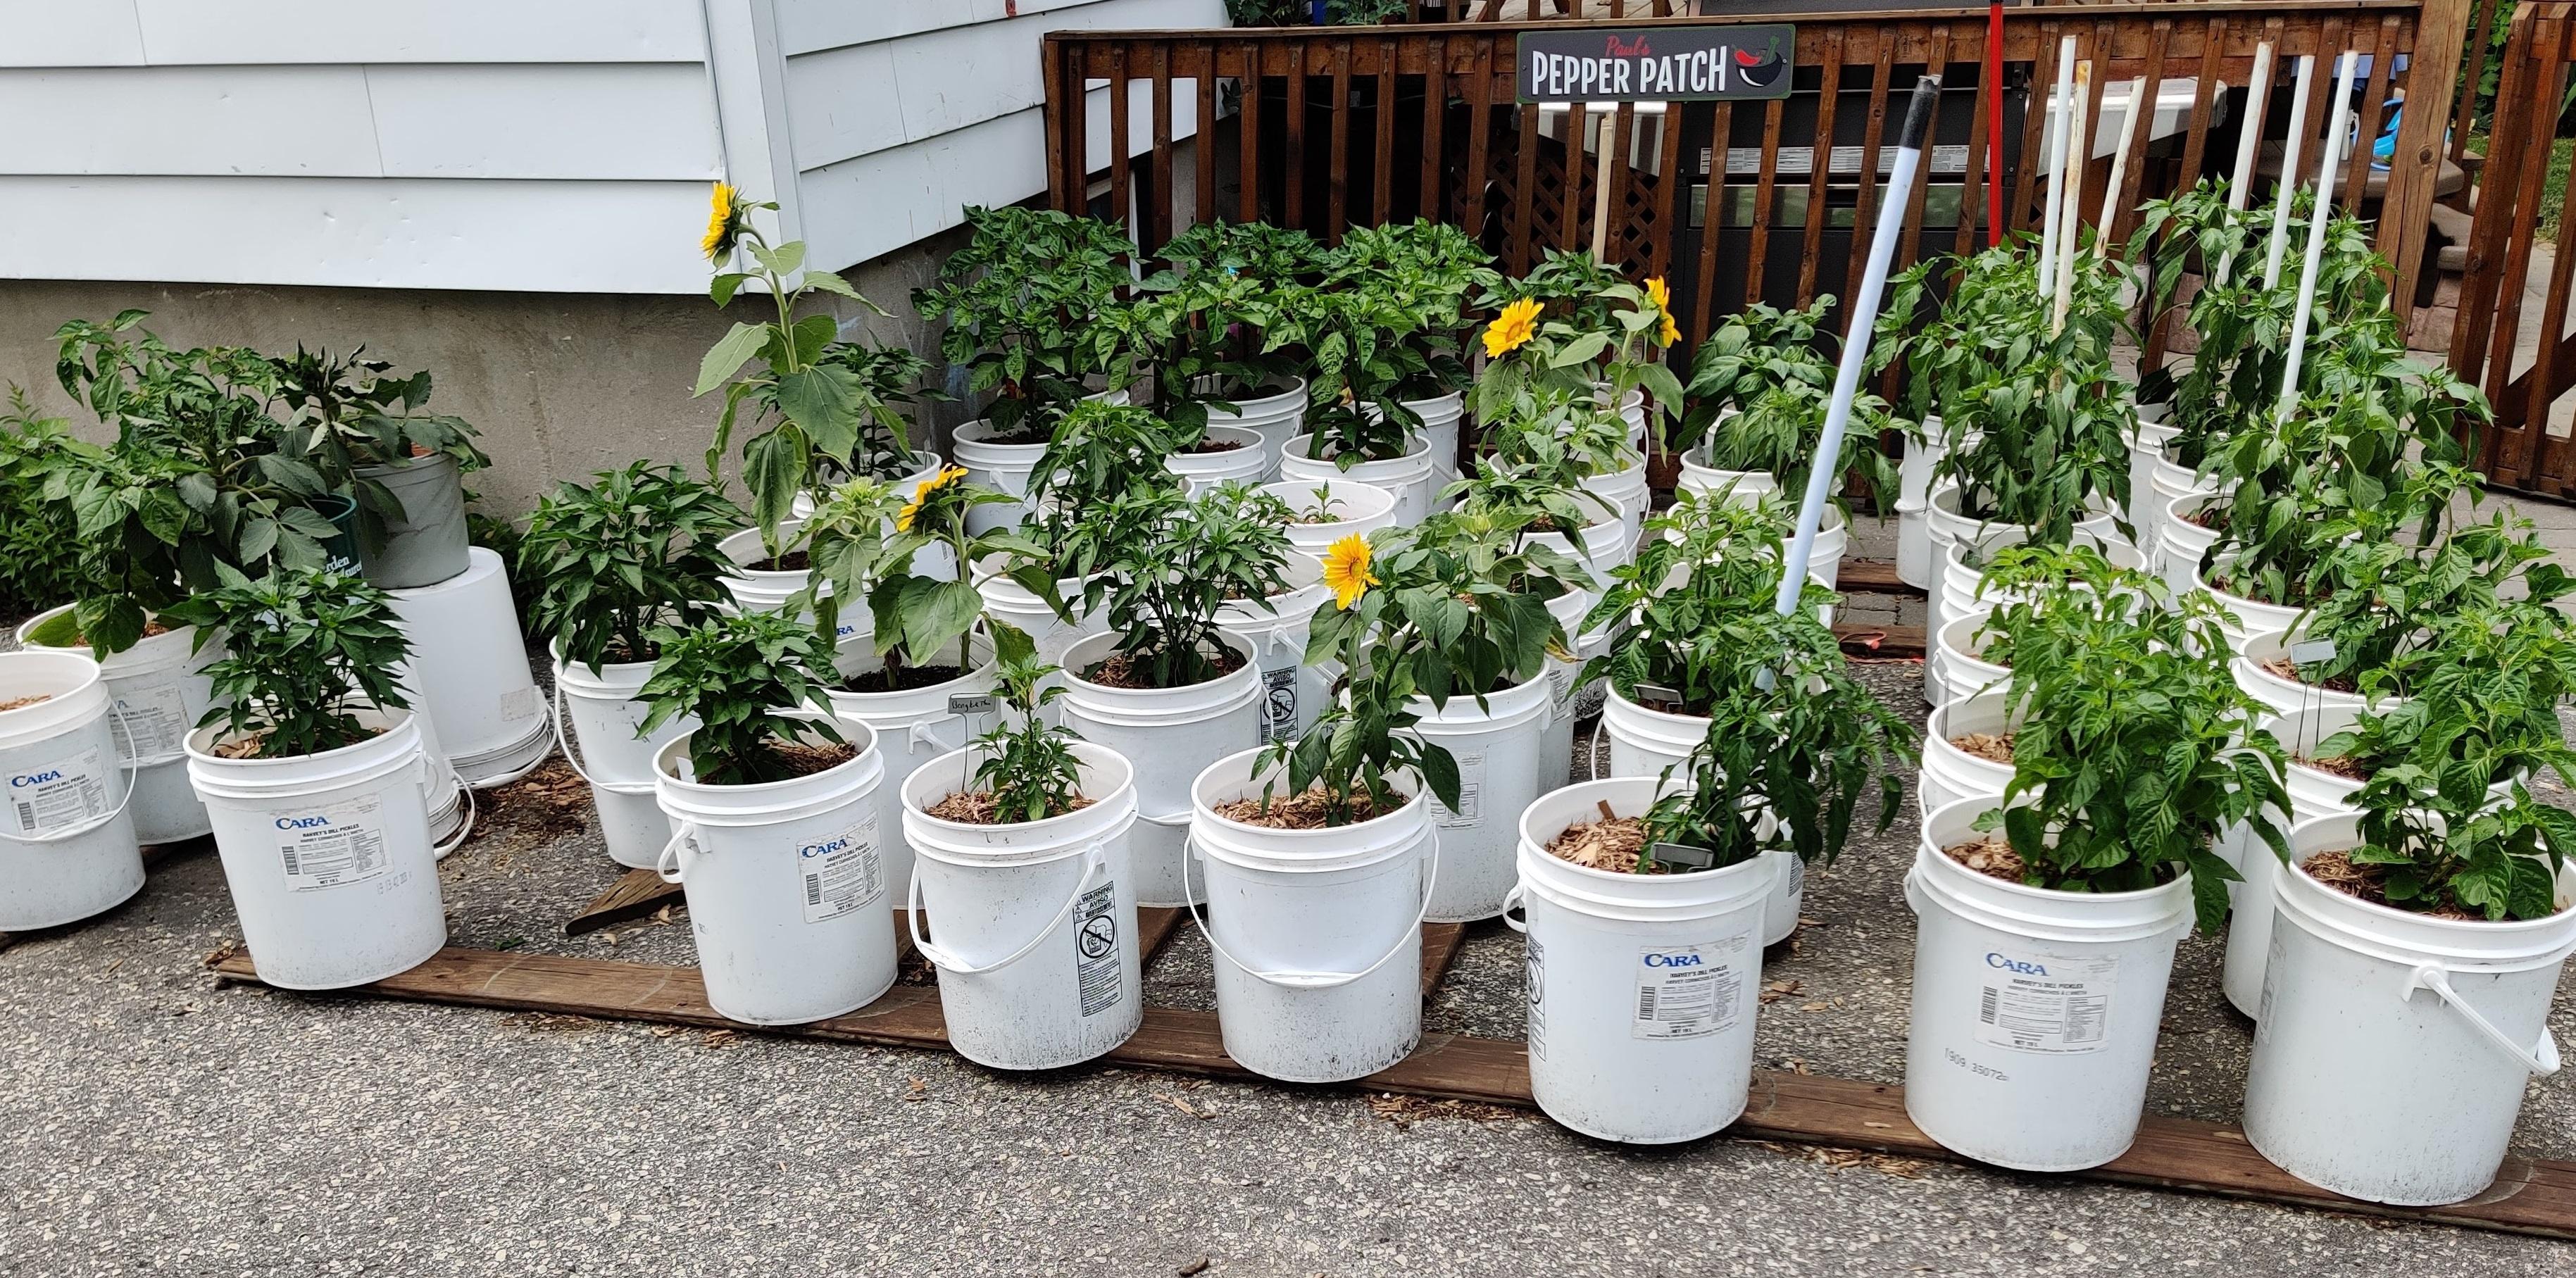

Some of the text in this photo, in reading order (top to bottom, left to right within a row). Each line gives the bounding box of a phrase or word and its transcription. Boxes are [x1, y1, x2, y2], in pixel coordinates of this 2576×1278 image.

[1605, 33, 1651, 57] Paul's
[1532, 45, 1727, 95] PEPPER PATCH
[11, 770, 62, 787] CARA
[275, 816, 330, 830] CARA
[802, 839, 848, 858] CARA
[1081, 884, 1113, 902] WARNING
[1089, 895, 1108, 908] AVISO
[1644, 953, 1701, 967] CARA
[1986, 952, 2049, 976] CARA
